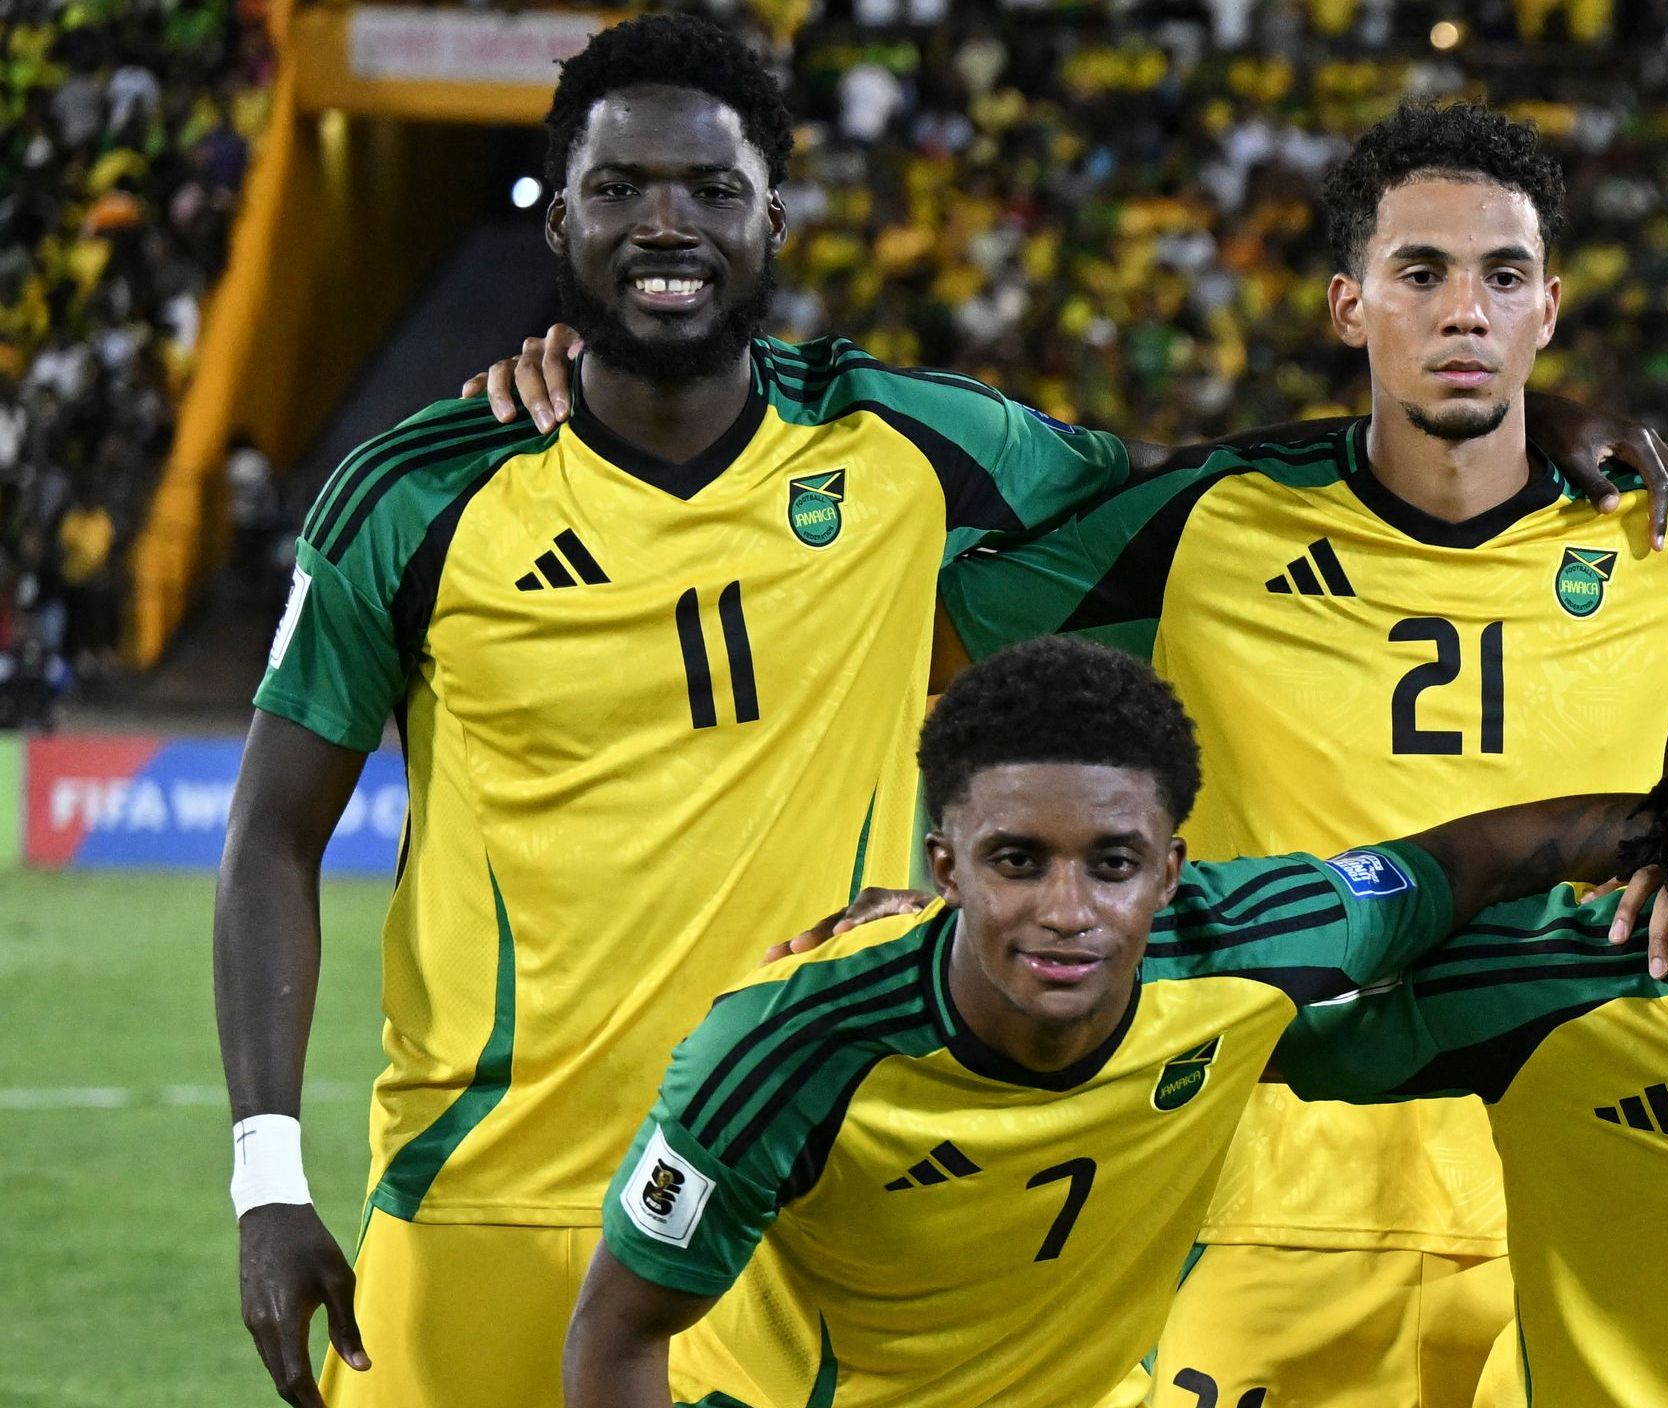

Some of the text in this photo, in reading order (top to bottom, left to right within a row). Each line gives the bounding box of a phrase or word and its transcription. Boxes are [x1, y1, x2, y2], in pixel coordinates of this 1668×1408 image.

[795, 507, 836, 528] JAMAICA
[1559, 579, 1599, 596] JAMAICA
[676, 581, 759, 729] 11
[1389, 618, 1503, 754] 21
[52, 776, 168, 832] FIFA
[1026, 1157, 1097, 1263] 7
